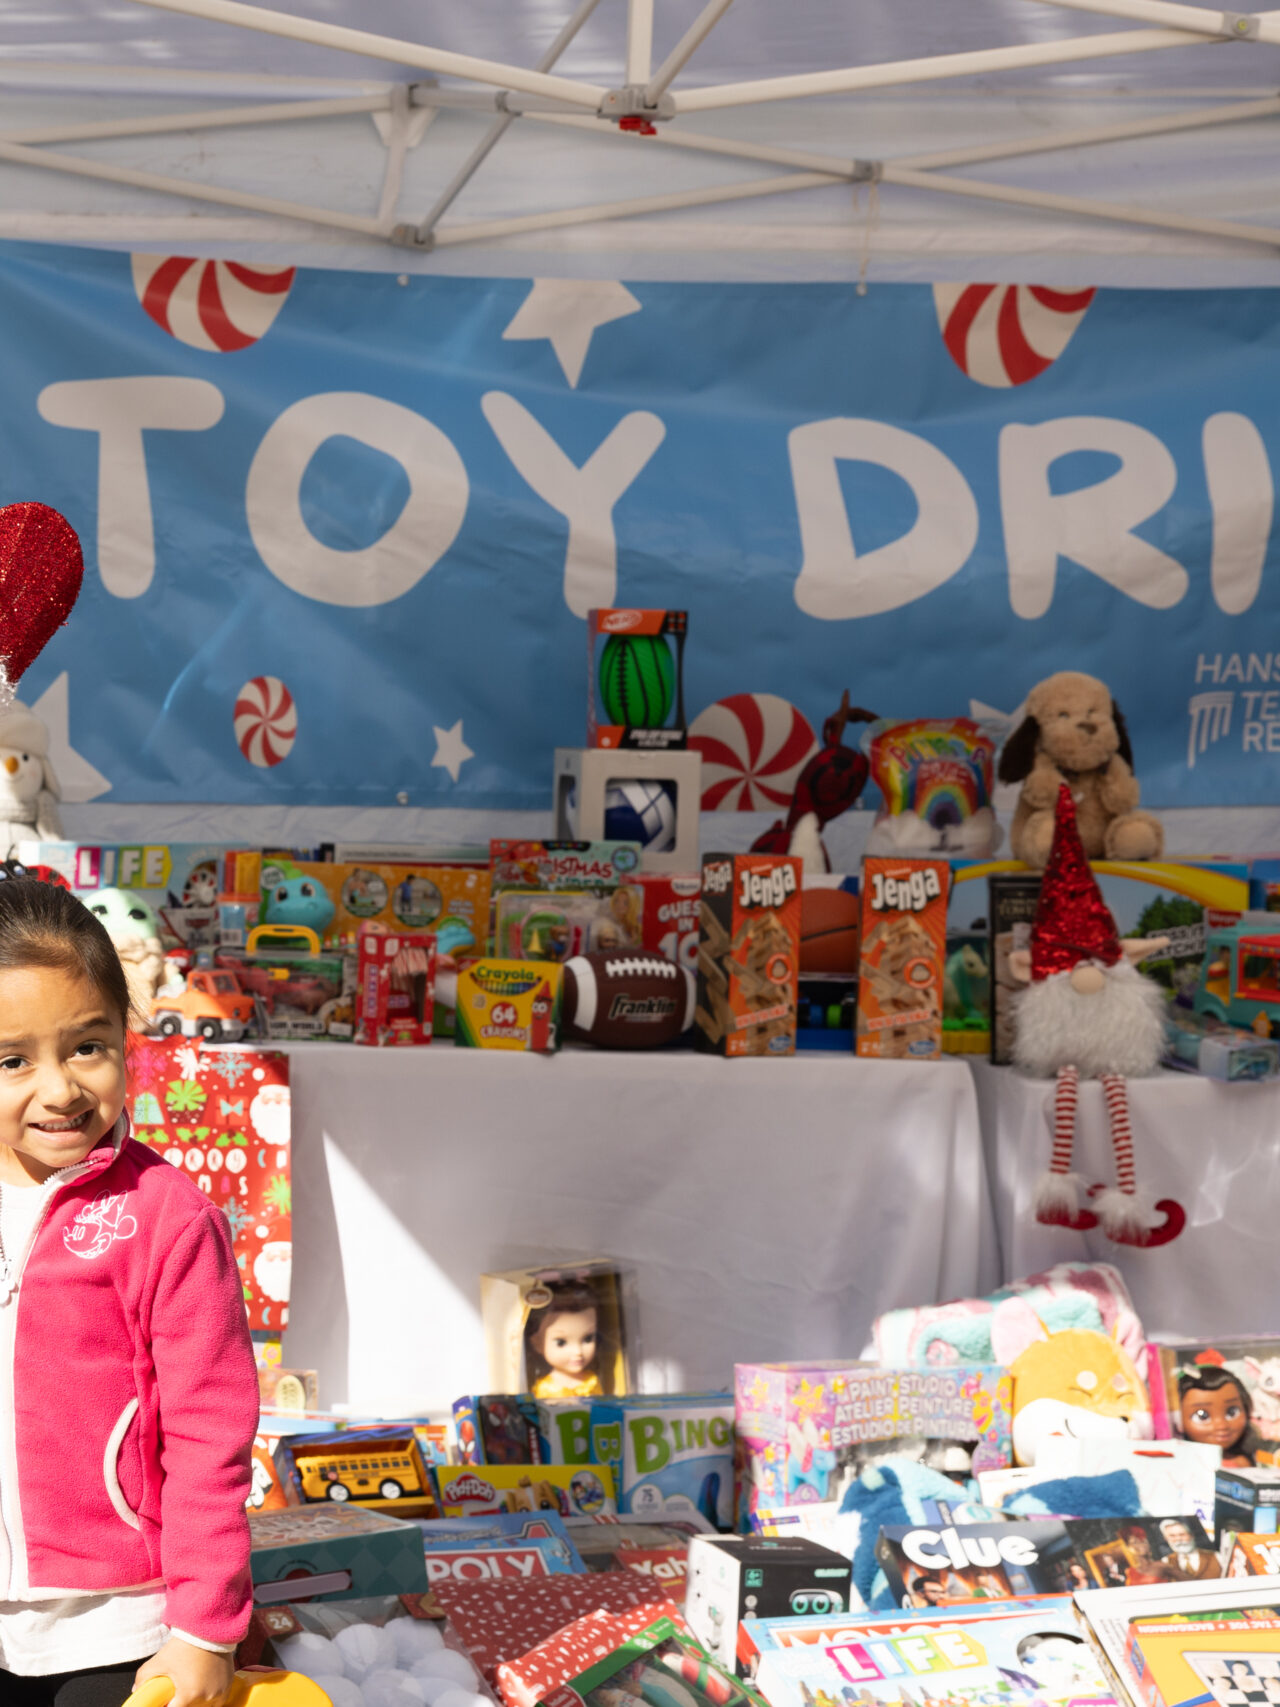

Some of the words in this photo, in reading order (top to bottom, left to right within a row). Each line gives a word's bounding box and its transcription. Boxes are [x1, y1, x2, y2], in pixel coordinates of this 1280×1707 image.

[37, 376, 666, 620] TOY
[788, 411, 1274, 620] DRI
[78, 850, 164, 886] LIFE
[739, 864, 796, 907] Jenga
[871, 868, 940, 911] Jenga
[658, 900, 701, 922] GUES
[477, 966, 534, 981] Crayola
[492, 1005, 515, 1024] 64
[608, 993, 676, 1019] Franklin
[849, 1378, 894, 1401] PAINT
[899, 1374, 956, 1398] STUDIO
[835, 1399, 894, 1425] ATELIER
[629, 1416, 735, 1474] BING
[831, 1420, 894, 1448] ESTUDIO
[901, 1527, 1039, 1570] Clue
[426, 1554, 535, 1581] POLY
[629, 1557, 688, 1578] Yah
[270, 1616, 293, 1629] 24
[832, 1632, 980, 1680] LIFE
